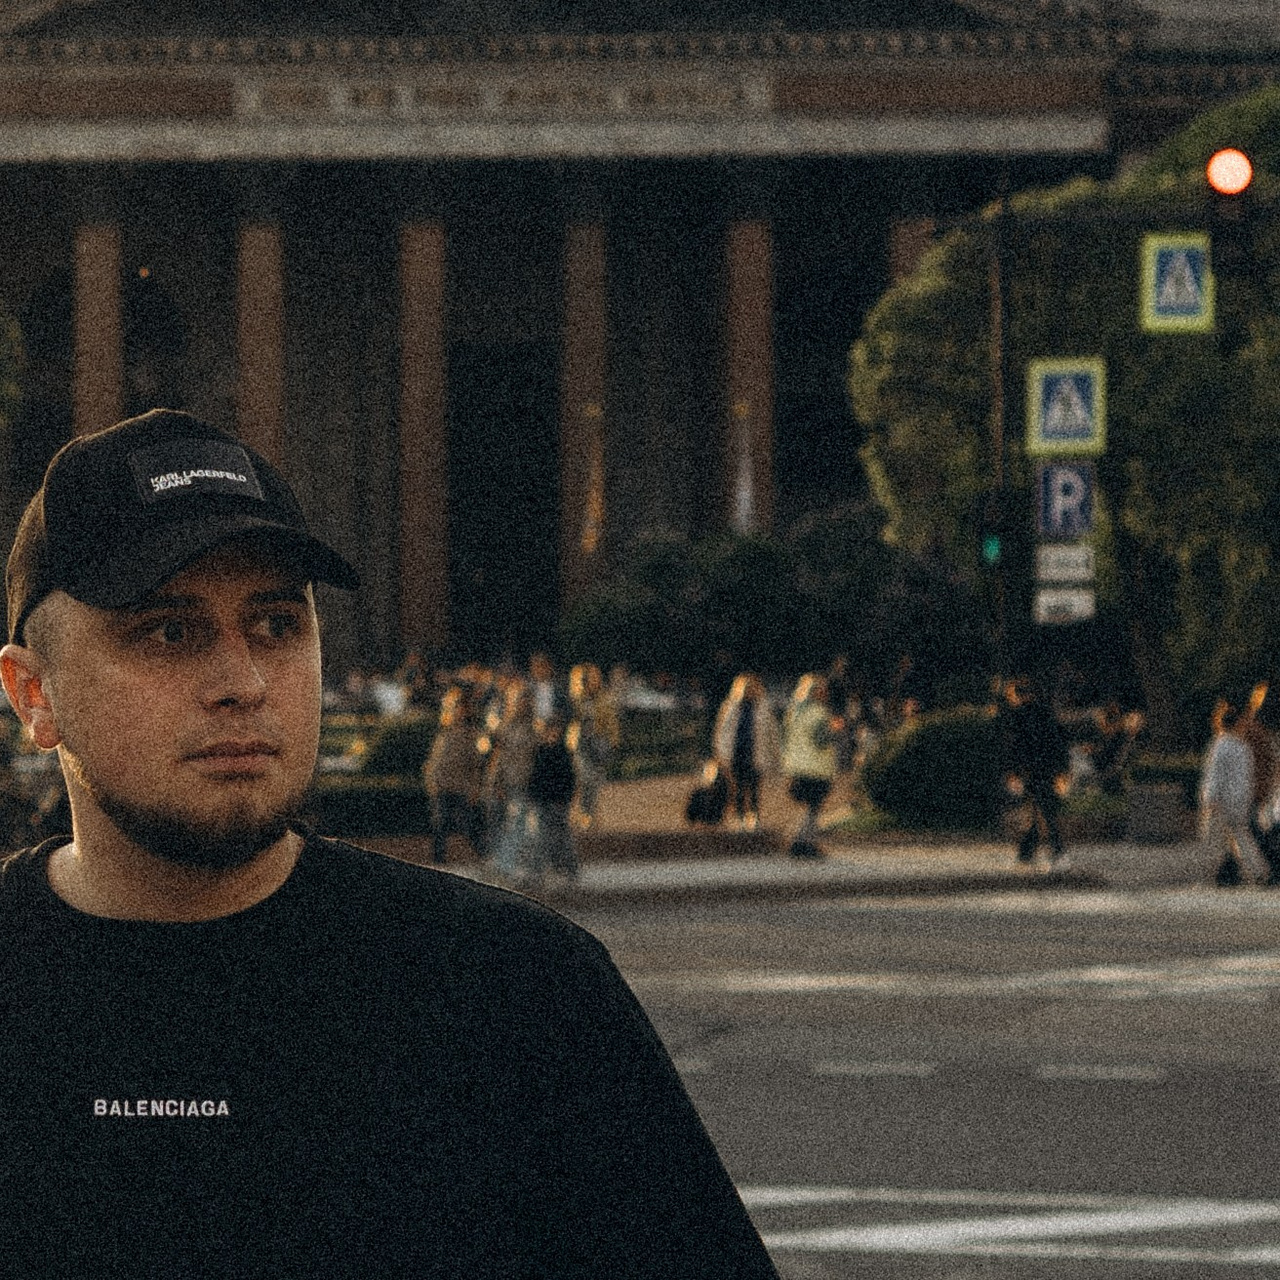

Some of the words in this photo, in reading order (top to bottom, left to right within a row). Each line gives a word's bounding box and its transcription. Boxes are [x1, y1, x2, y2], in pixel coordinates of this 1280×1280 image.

[150, 472, 182, 485] KARL
[183, 470, 247, 483] LAGERFELD
[151, 477, 192, 493] JEANS
[93, 1099, 229, 1117] BALENCIAGA
